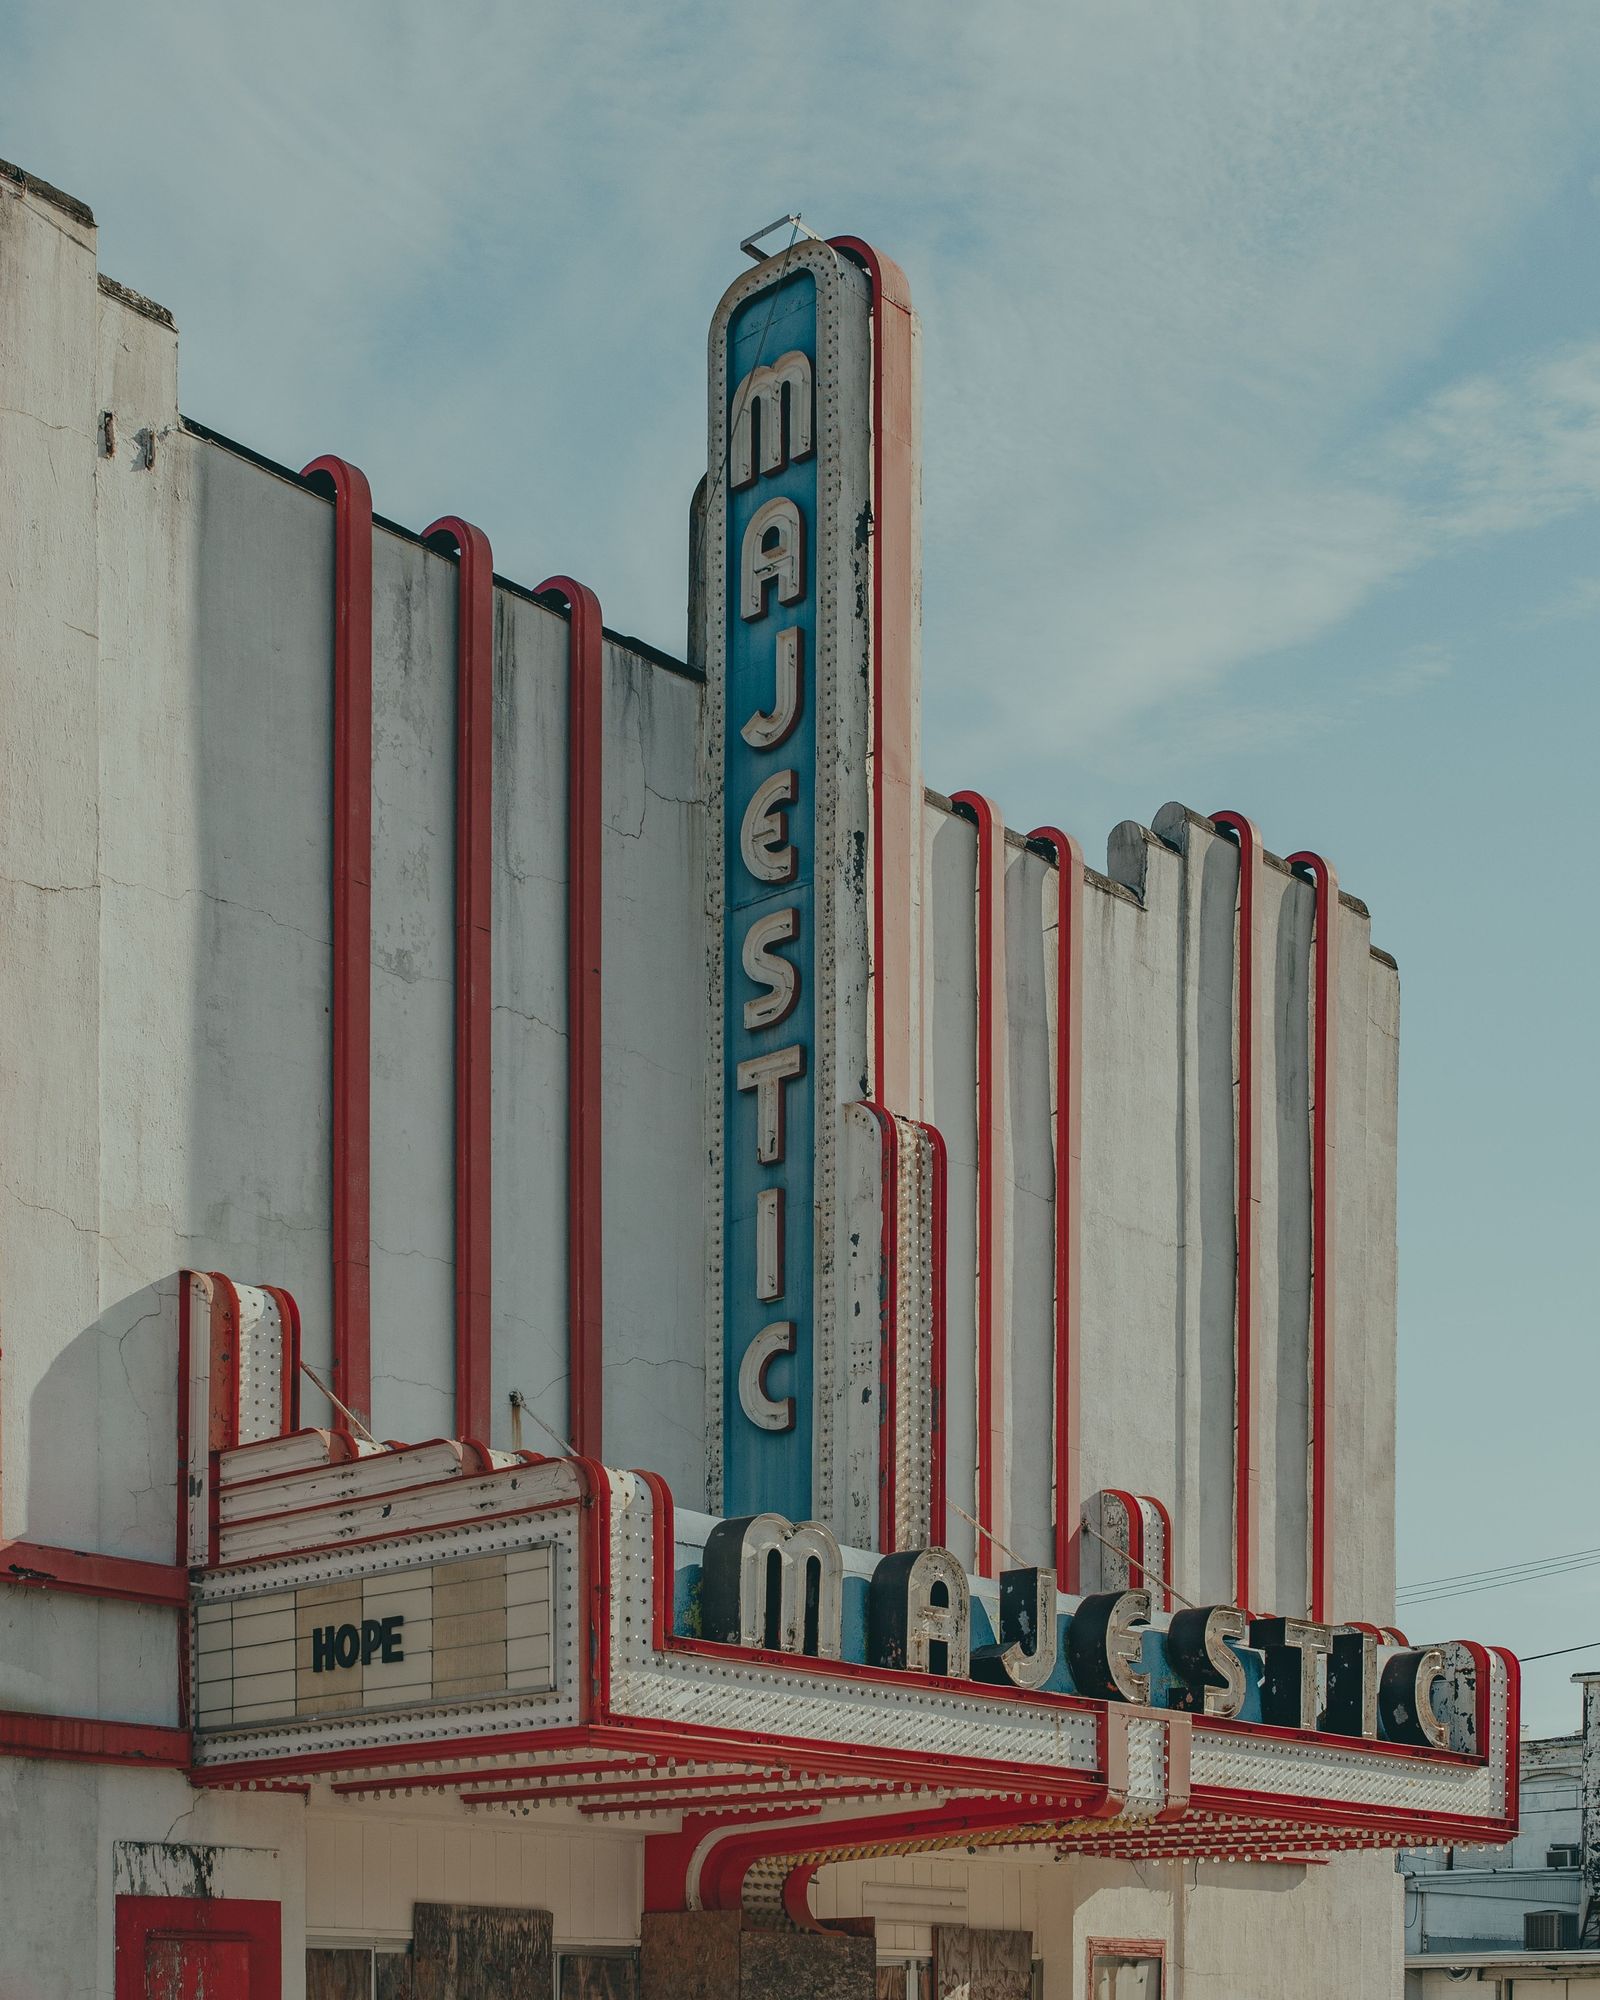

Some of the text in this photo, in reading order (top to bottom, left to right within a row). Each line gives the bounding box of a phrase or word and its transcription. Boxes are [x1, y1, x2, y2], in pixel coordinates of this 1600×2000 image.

[731, 350, 816, 1431] MAJESTIC
[312, 1615, 404, 1673] HOPE
[703, 1512, 1451, 1750] MAJESTIC
